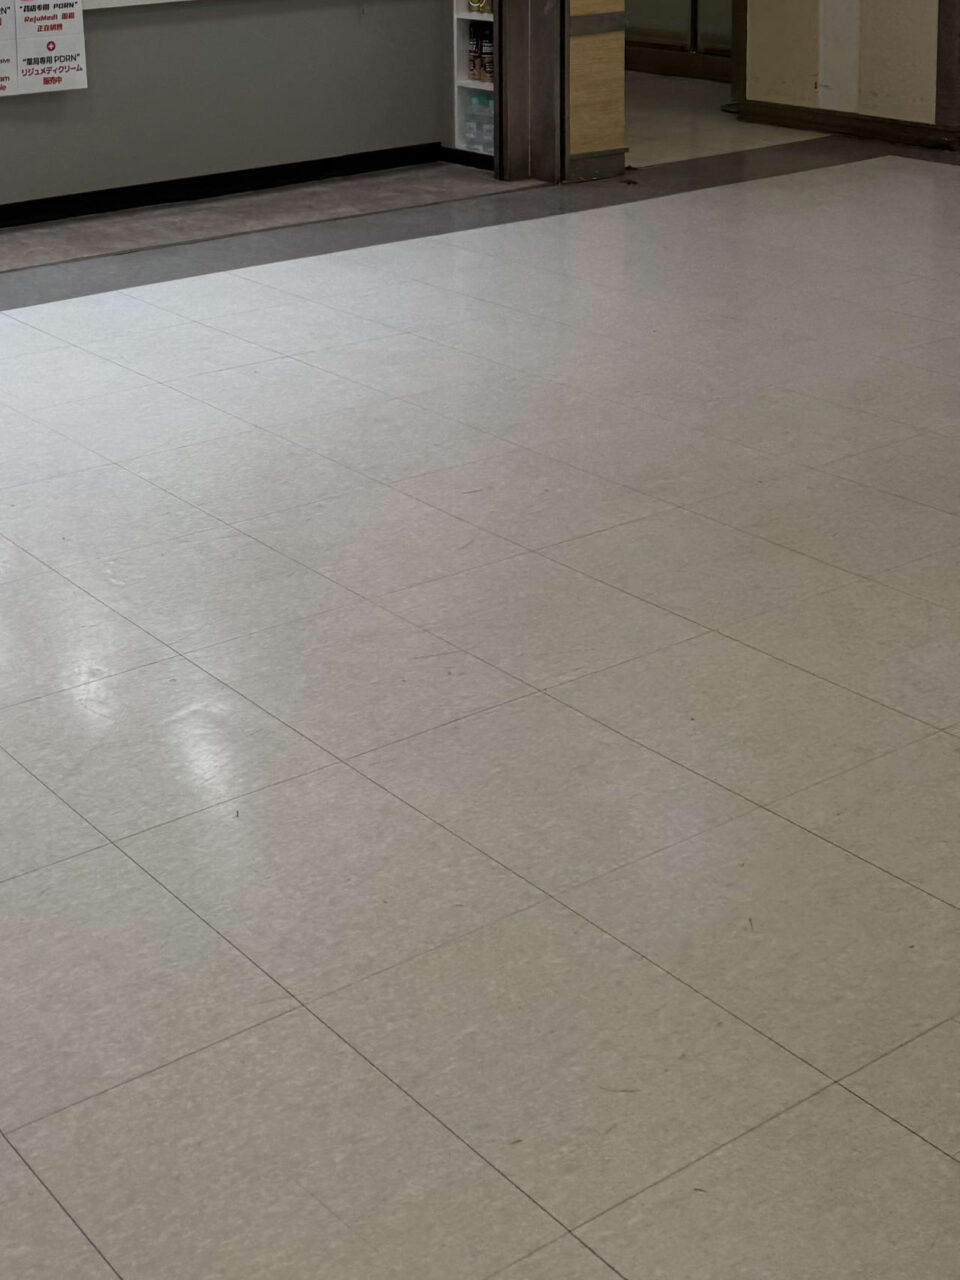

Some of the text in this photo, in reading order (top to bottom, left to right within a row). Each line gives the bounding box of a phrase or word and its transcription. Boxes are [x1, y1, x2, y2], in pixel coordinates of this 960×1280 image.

[21, 64, 83, 77] リジュメディクリーム
